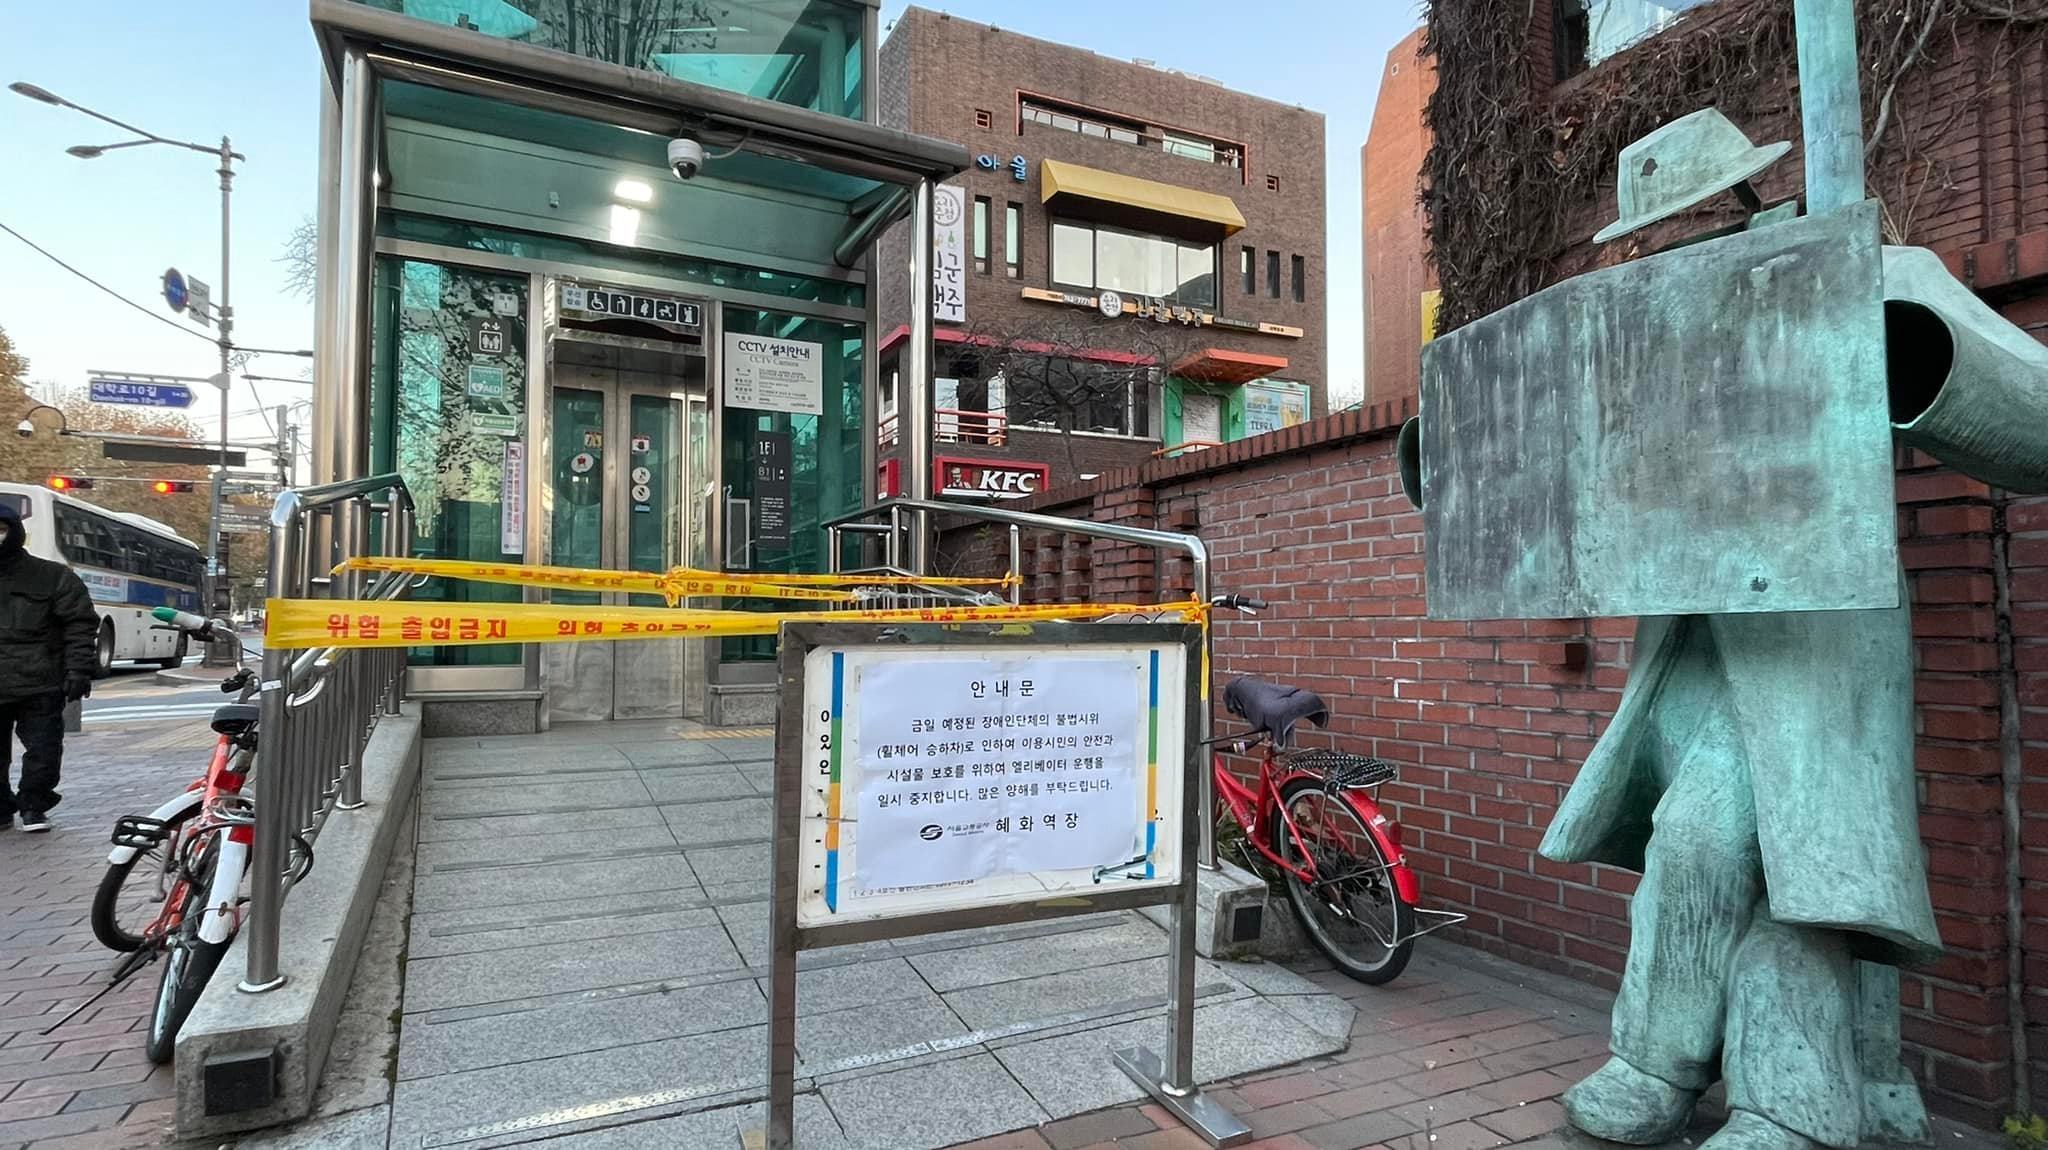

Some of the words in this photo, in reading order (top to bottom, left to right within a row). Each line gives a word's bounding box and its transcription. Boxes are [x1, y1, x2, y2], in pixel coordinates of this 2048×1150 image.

[738, 340, 767, 353] CCTV
[769, 344, 810, 359] 설치안내
[749, 355, 771, 364] CCTV
[92, 383, 157, 397] 대학로10길
[483, 384, 500, 395] AED
[979, 470, 1035, 493] KFC
[327, 614, 379, 638] 위험
[402, 616, 507, 639] 출입금지
[912, 719, 935, 732] 금일
[942, 717, 975, 731] 예정된
[982, 714, 1049, 729] 장애인단체의
[1056, 712, 1099, 726] 불법시위
[877, 744, 918, 759] (휠체어
[926, 741, 975, 757] 승하차)로
[982, 738, 1015, 752] 인하여
[1022, 735, 1077, 750] 이용시민의
[1083, 734, 1113, 747] 안전과
[887, 767, 924, 782] 시설물
[931, 764, 964, 779] 보호를
[972, 761, 1005, 776] 위하여
[1012, 759, 1067, 774] 엘리베이터
[1073, 756, 1104, 770] 운행을
[878, 793, 901, 808] 일시
[909, 788, 972, 806] 중지합니다.
[978, 786, 1000, 800] 많은
[1006, 783, 1039, 798] 양해를
[1046, 778, 1113, 795] 부탁드립니다.
